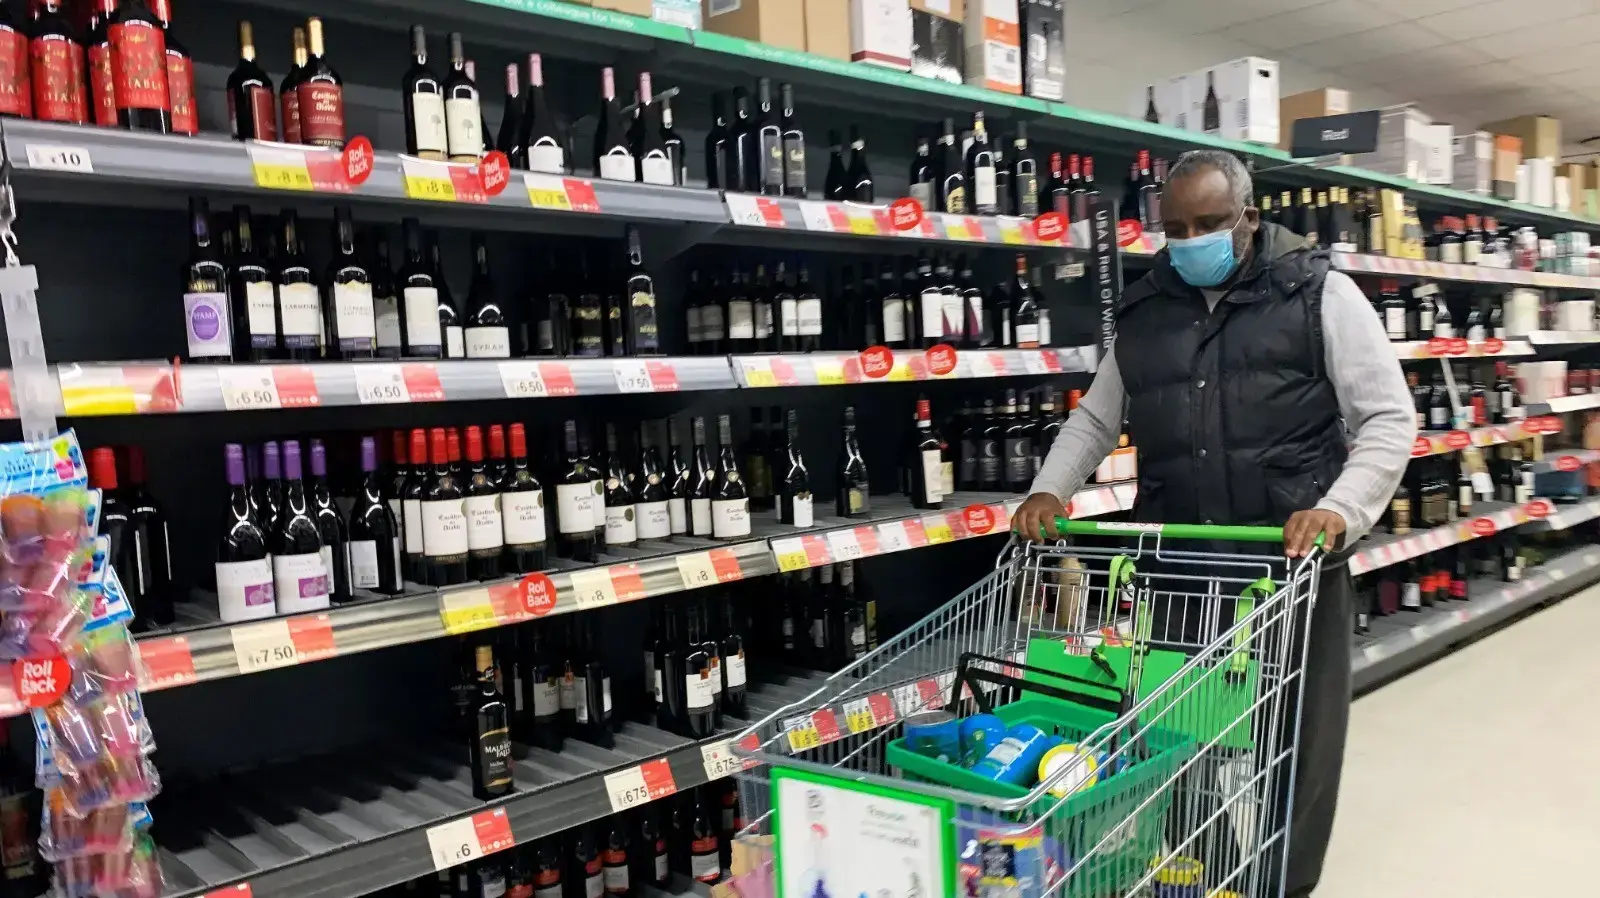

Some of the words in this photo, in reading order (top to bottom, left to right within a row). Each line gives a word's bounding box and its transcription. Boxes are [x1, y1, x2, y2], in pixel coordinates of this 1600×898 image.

[349, 145, 364, 162] Roll
[348, 159, 368, 178] Back
[484, 158, 500, 175] Roll
[485, 171, 505, 189] Back
[528, 581, 545, 595] Roll
[591, 589, 605, 603] £8
[527, 593, 551, 607] Back
[23, 660, 53, 679] Roll
[21, 677, 56, 695] Back
[456, 843, 471, 859] £6
